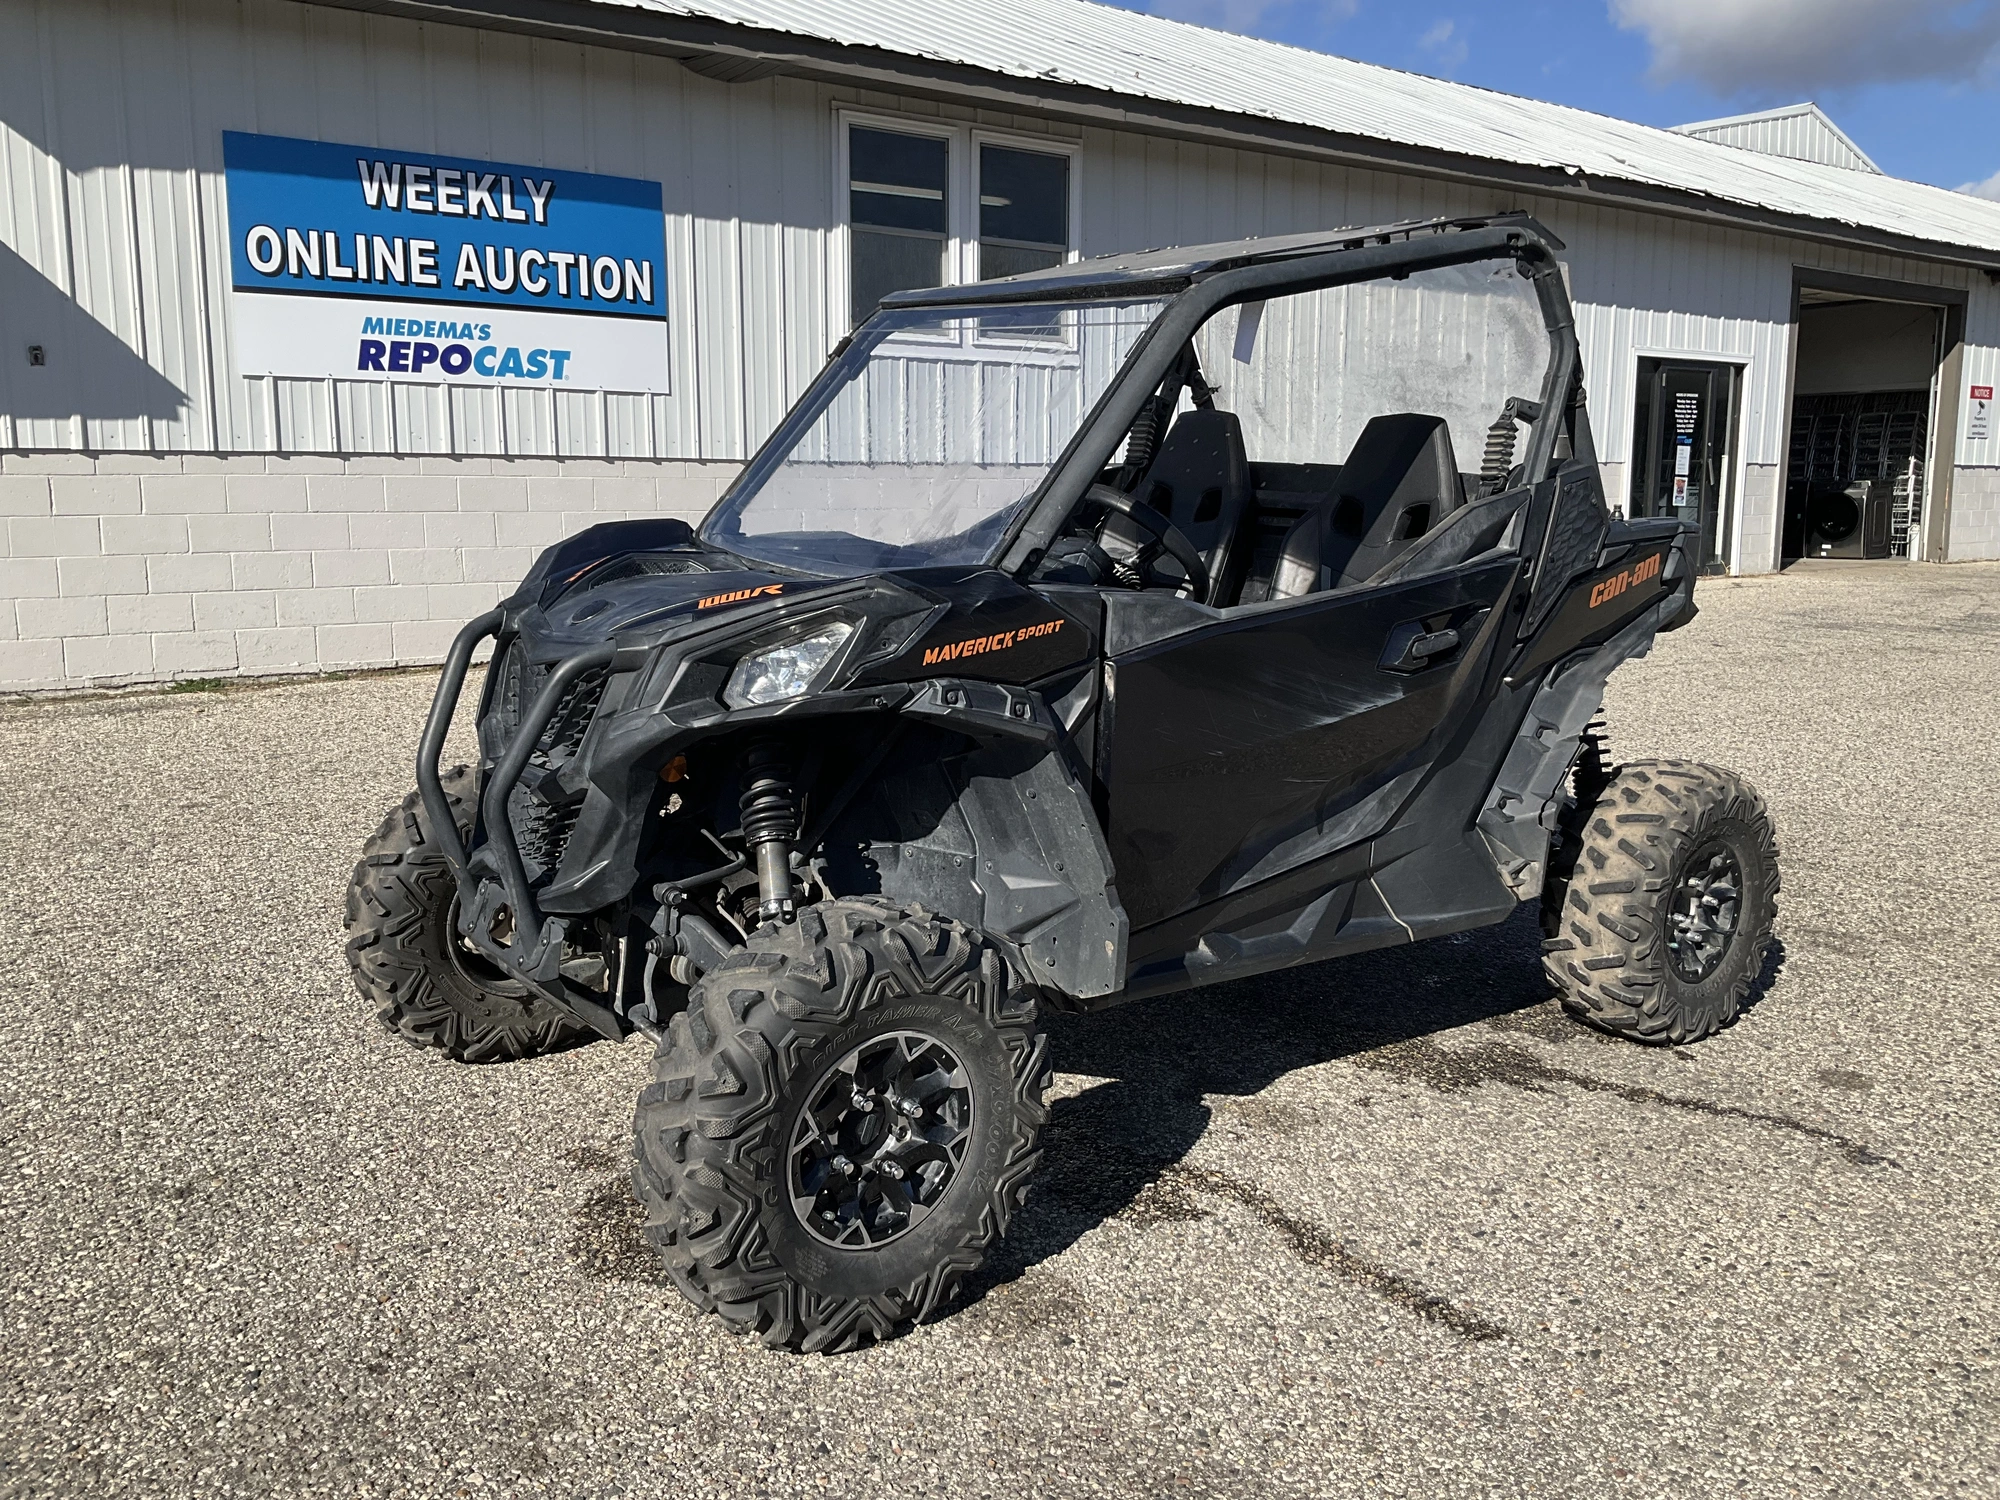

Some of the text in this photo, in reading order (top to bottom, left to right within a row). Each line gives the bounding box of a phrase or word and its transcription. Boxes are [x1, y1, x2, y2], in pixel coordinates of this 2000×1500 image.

[357, 158, 555, 225] WEEKLY
[245, 224, 653, 303] ONLINE AUCTION
[361, 316, 492, 342] MIEDEMA'S
[357, 340, 572, 381] REPOCAST
[1974, 388, 1990, 398] NOTICE
[697, 583, 784, 609] 1000R
[1589, 552, 1661, 609] can-am
[922, 619, 1065, 667] MAVERICK SPORT
[866, 1003, 942, 1029] TAMER
